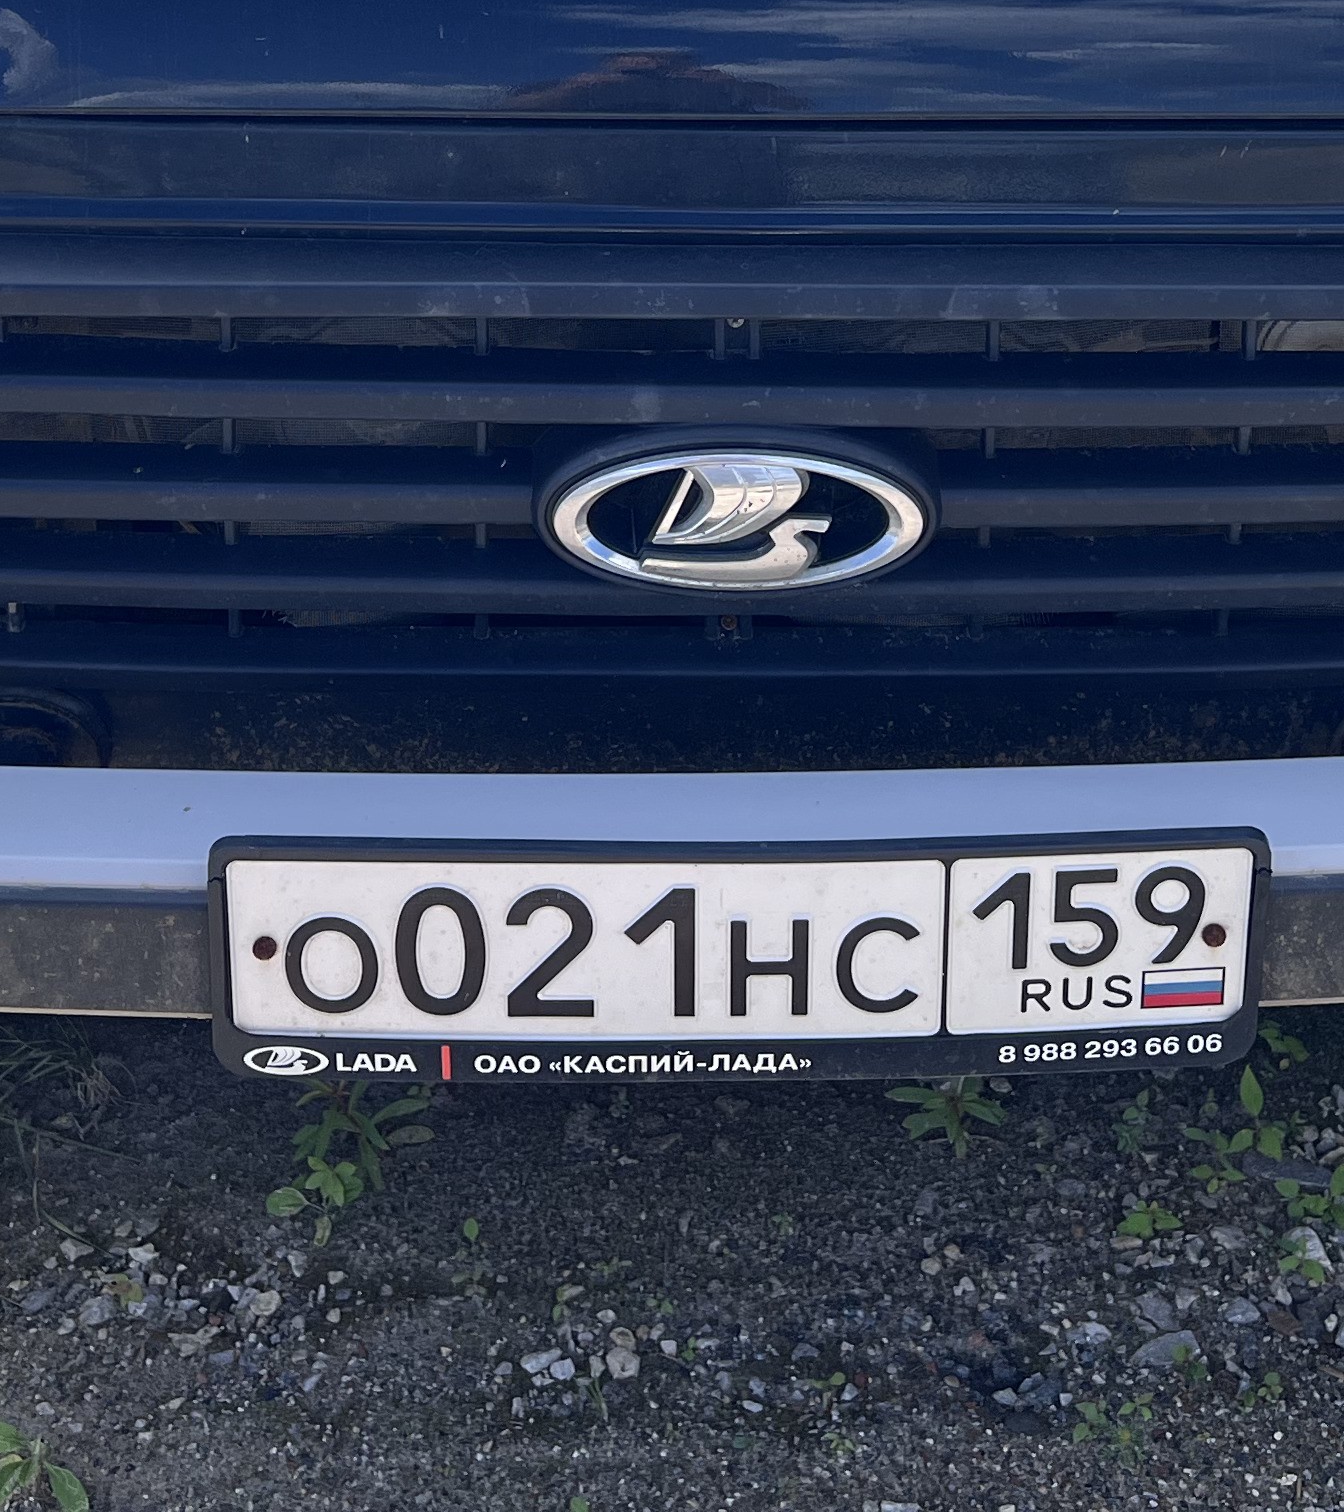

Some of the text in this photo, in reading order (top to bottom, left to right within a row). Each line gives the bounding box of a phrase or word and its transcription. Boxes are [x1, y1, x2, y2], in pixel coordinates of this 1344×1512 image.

[972, 865, 1206, 970] 159
[1020, 975, 1133, 1013] RUS
[335, 1052, 418, 1073] LADA
[473, 1049, 812, 1075] ОАО «КАСПИЙ-ЛАДА»
[997, 1033, 1223, 1064] 8 988 293 66 06
